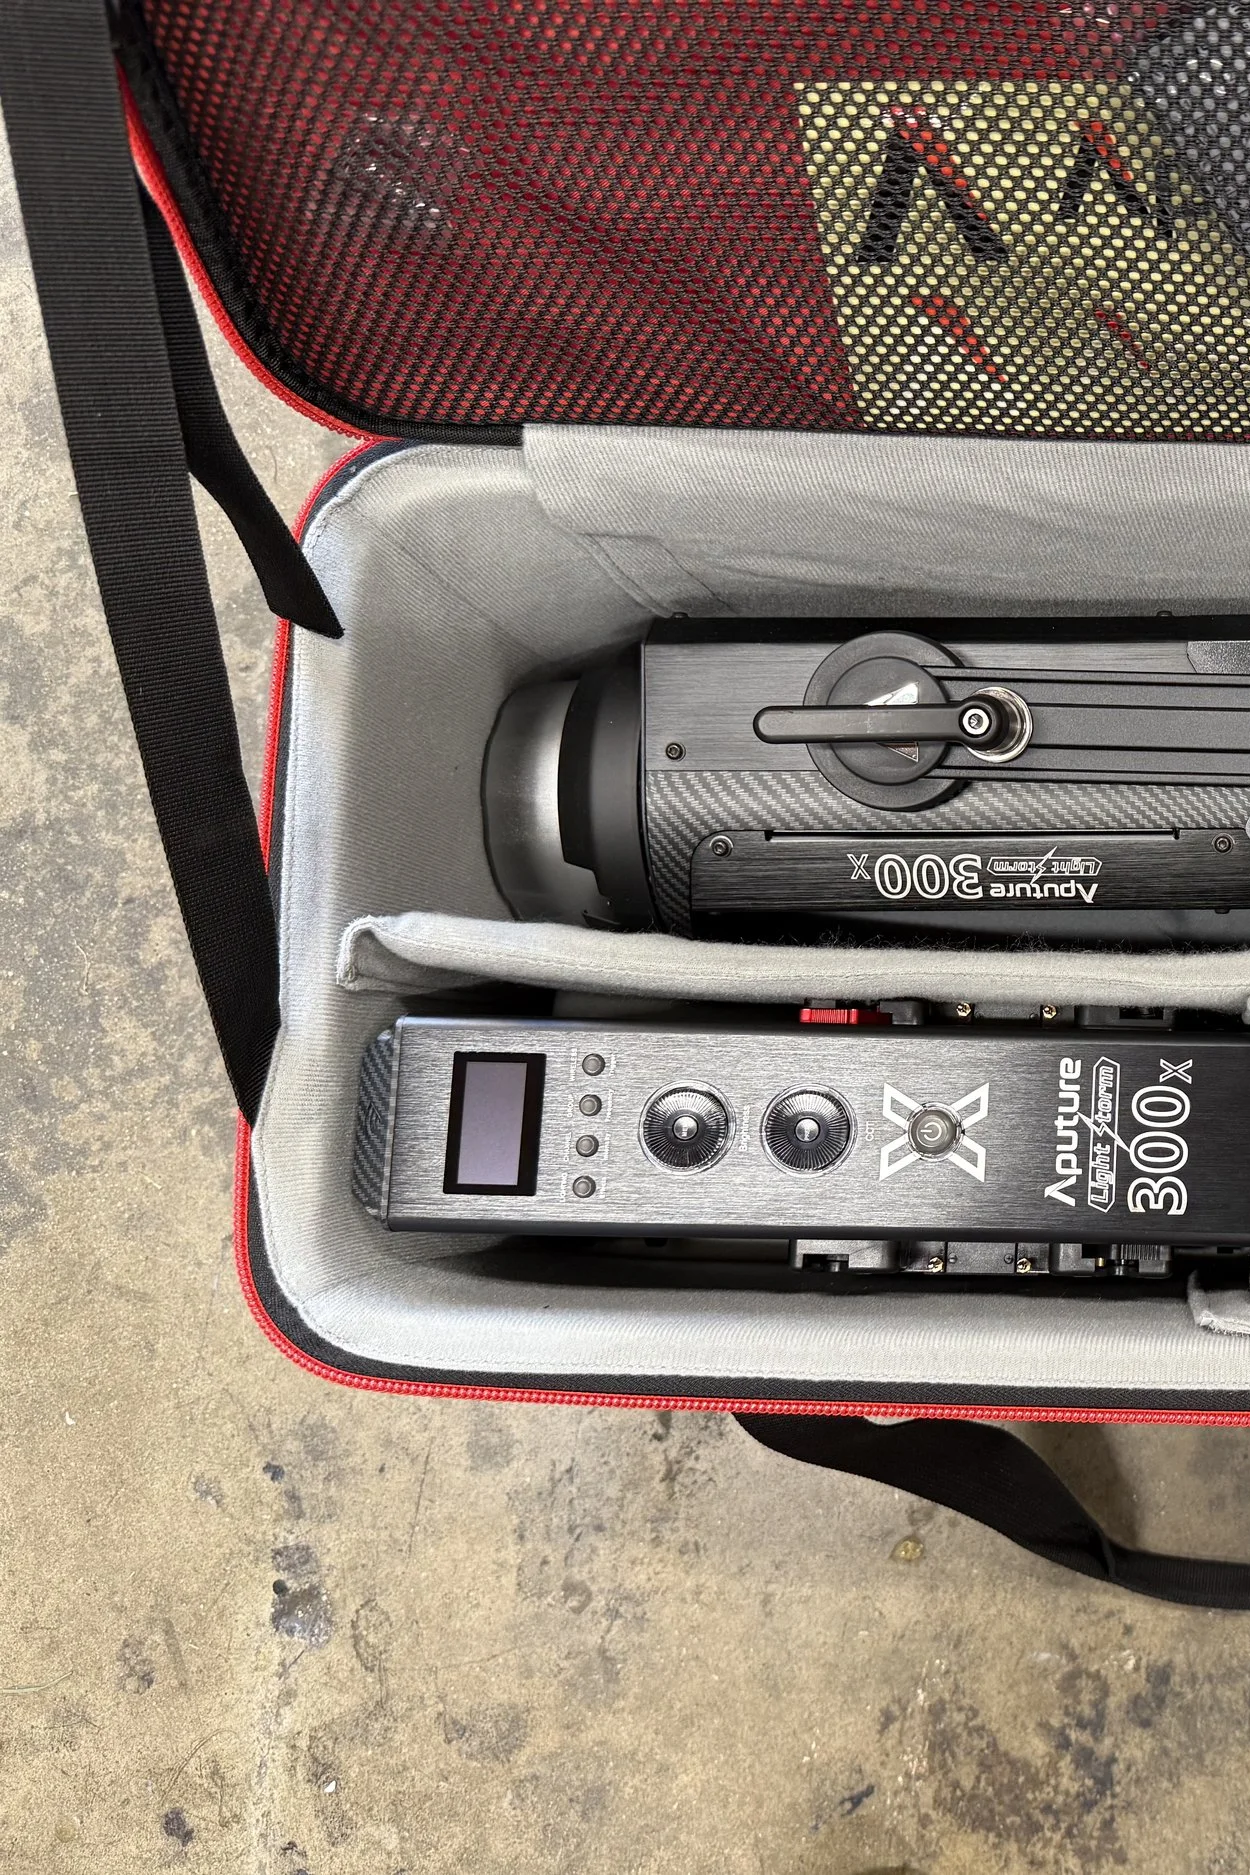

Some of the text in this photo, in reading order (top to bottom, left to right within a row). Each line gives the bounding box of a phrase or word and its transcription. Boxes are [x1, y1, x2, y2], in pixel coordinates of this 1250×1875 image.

[1050, 857, 1096, 875] Light
[989, 879, 1099, 904] Aputure
[569, 1048, 578, 1081] WIRELESS
[566, 1093, 575, 1118] GROUP
[738, 1105, 751, 1152] Brightness
[865, 1121, 875, 1142] CCT
[1044, 1057, 1083, 1207] Aputure
[563, 1131, 573, 1162] CHANNEL
[1090, 1142, 1115, 1204] Light
